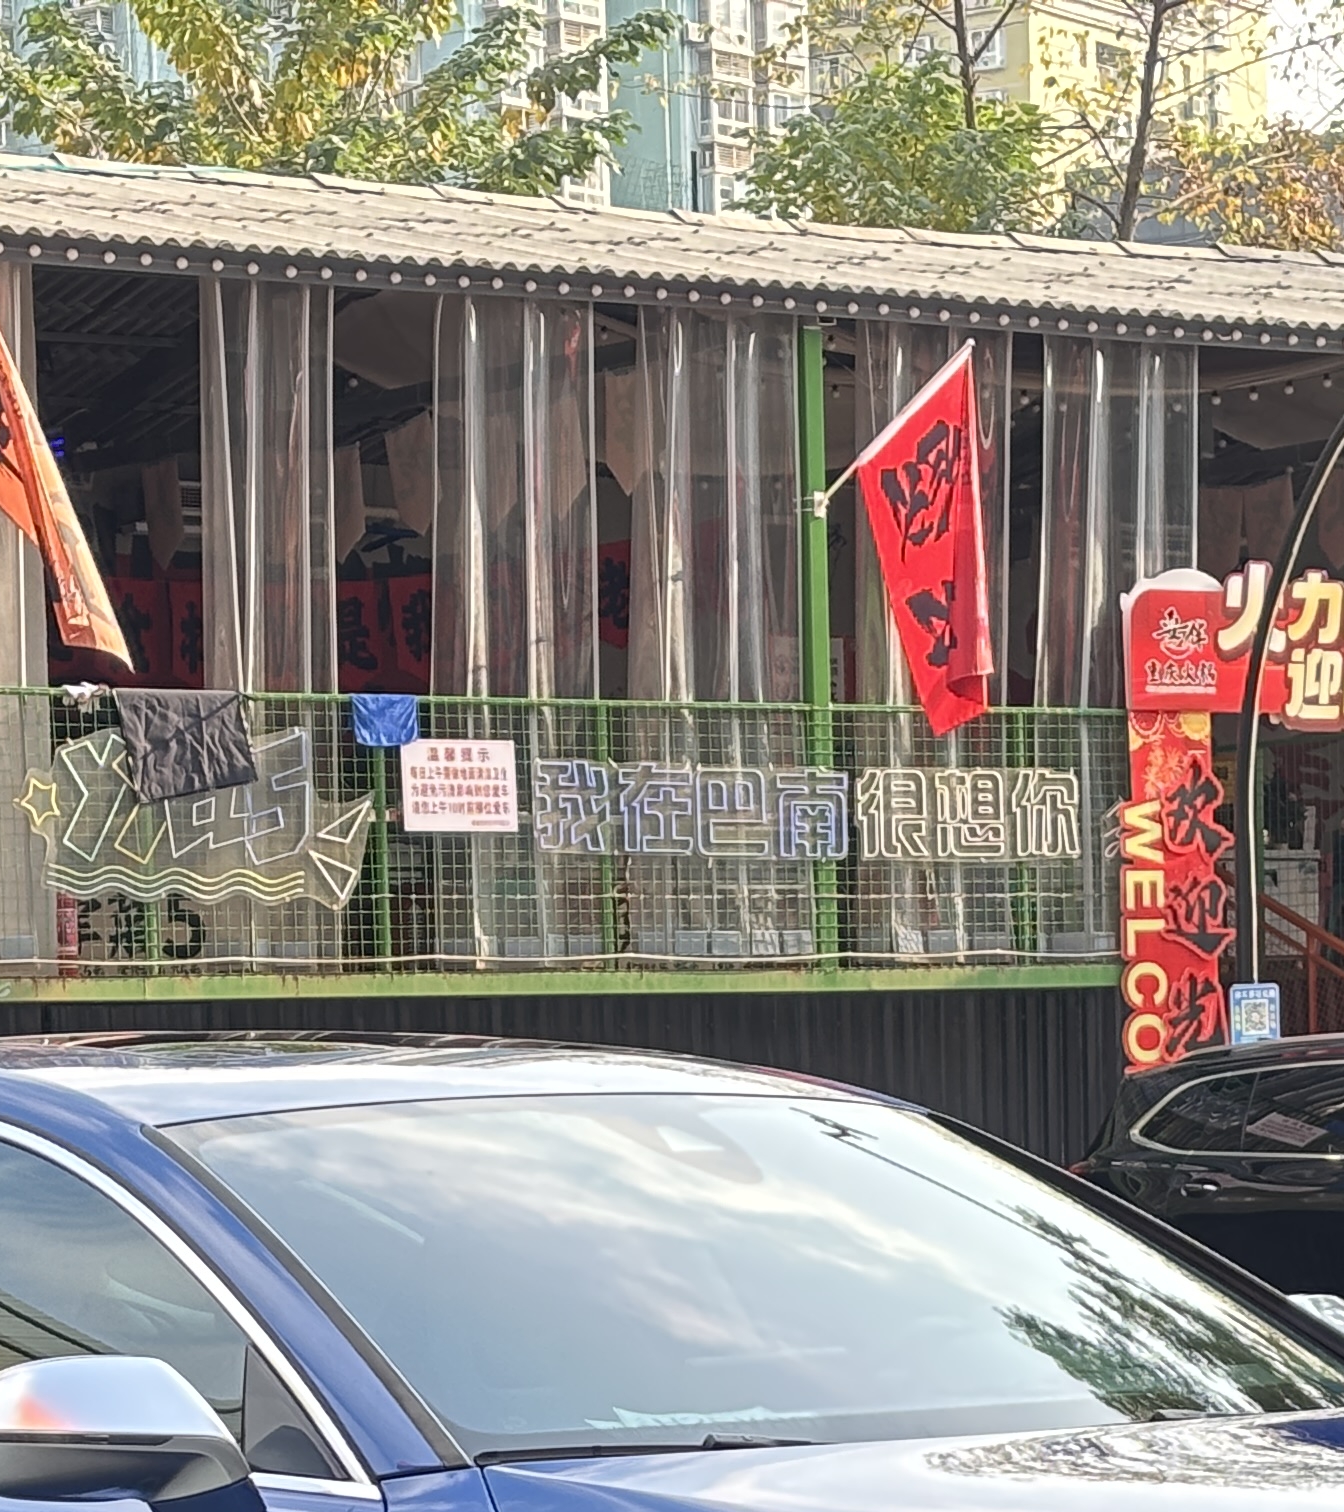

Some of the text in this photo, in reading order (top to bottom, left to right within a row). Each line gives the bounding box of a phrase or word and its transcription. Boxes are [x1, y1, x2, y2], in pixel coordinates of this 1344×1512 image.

[1146, 660, 1217, 685] 重庆火锅
[535, 759, 849, 858] 我在巴南
[856, 768, 1080, 859] 很想你
